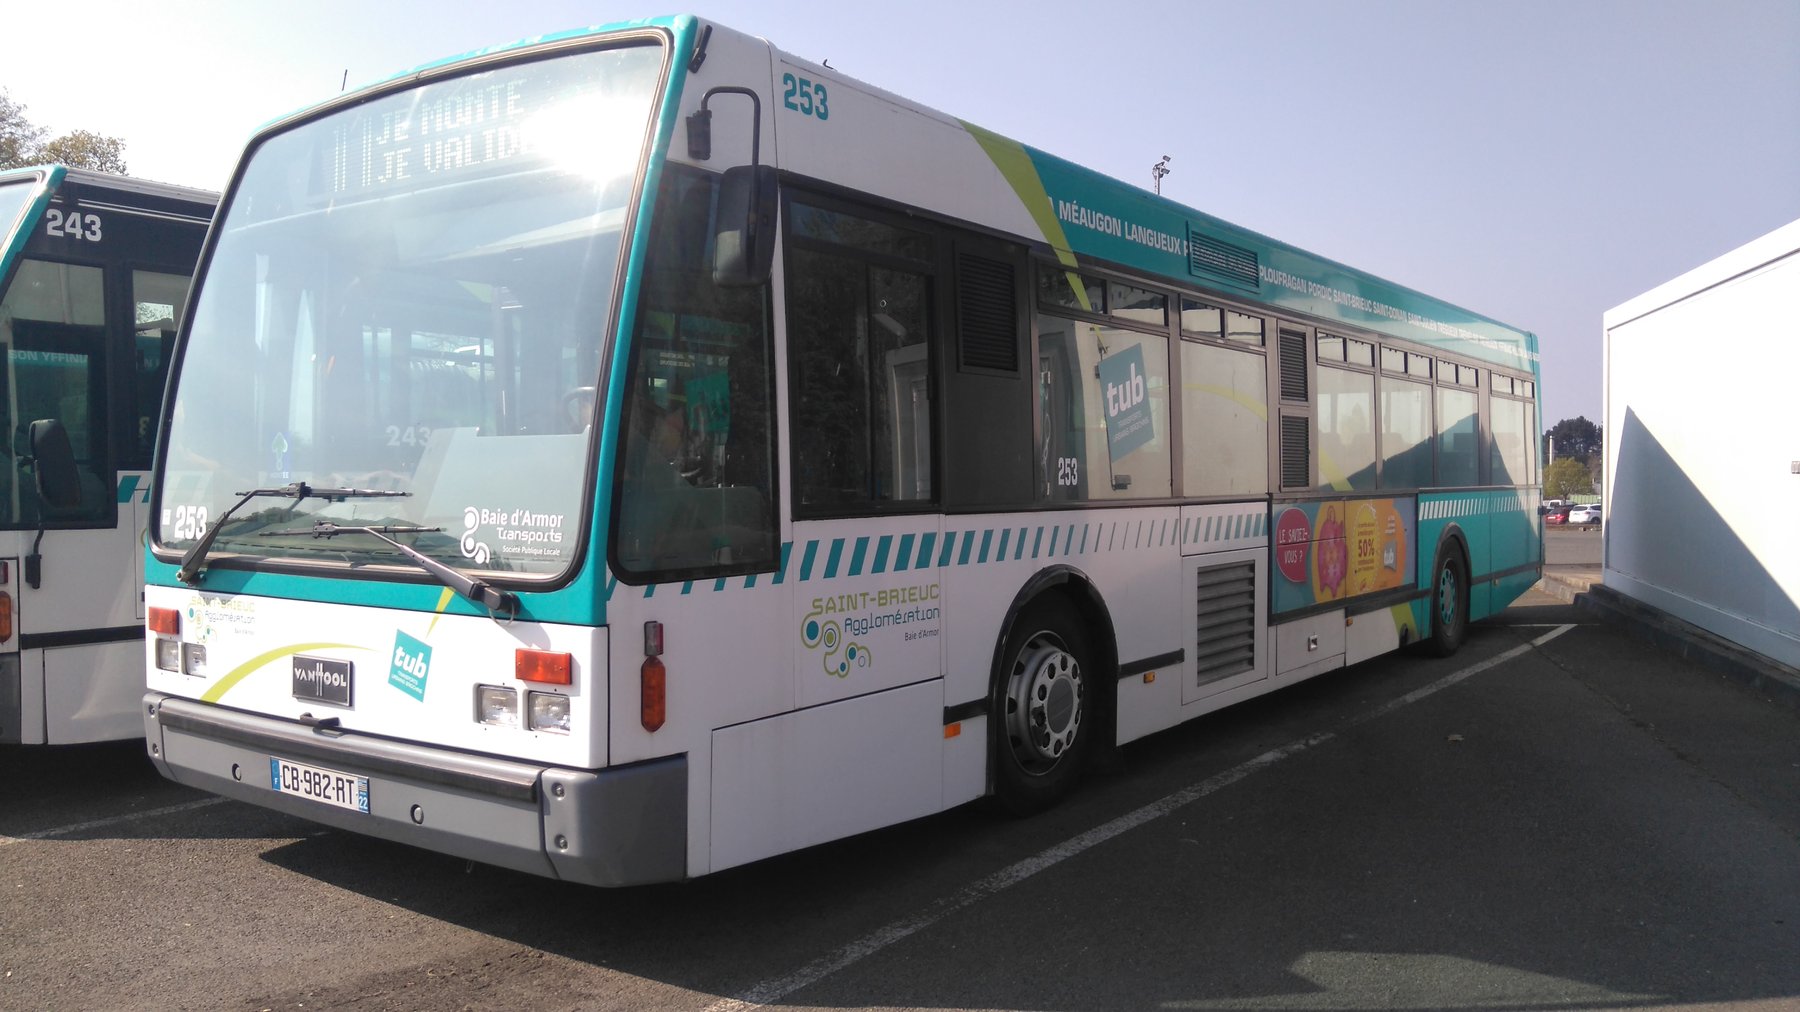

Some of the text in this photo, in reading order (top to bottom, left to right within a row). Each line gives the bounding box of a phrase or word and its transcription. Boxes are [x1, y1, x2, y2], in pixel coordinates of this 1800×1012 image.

[376, 79, 528, 145] JE MONTE
[783, 72, 829, 121] 253
[378, 125, 534, 183] JE VALID
[46, 208, 103, 242] 243
[1059, 200, 1181, 256] MÉAUGON LANGUEUX
[1259, 265, 1307, 294] PLOUFRAGAN
[1308, 280, 1332, 301] PORDIC
[1333, 289, 1373, 313] SAINT-BRIEUC
[1107, 362, 1144, 417] tub
[1058, 457, 1078, 486] 253
[174, 504, 208, 540] 253
[481, 508, 563, 528] Baie d'Armor
[496, 527, 562, 544] Transports
[502, 545, 560, 556] Société Publique Locale
[1279, 529, 1286, 543] LE
[1358, 538, 1375, 557] 50%
[812, 584, 939, 615] SAINT-BRIEUC
[904, 628, 939, 641] Baie d'Armor
[393, 646, 427, 678] tub
[282, 765, 355, 804] CB-982-RT
[358, 796, 369, 811] 22
